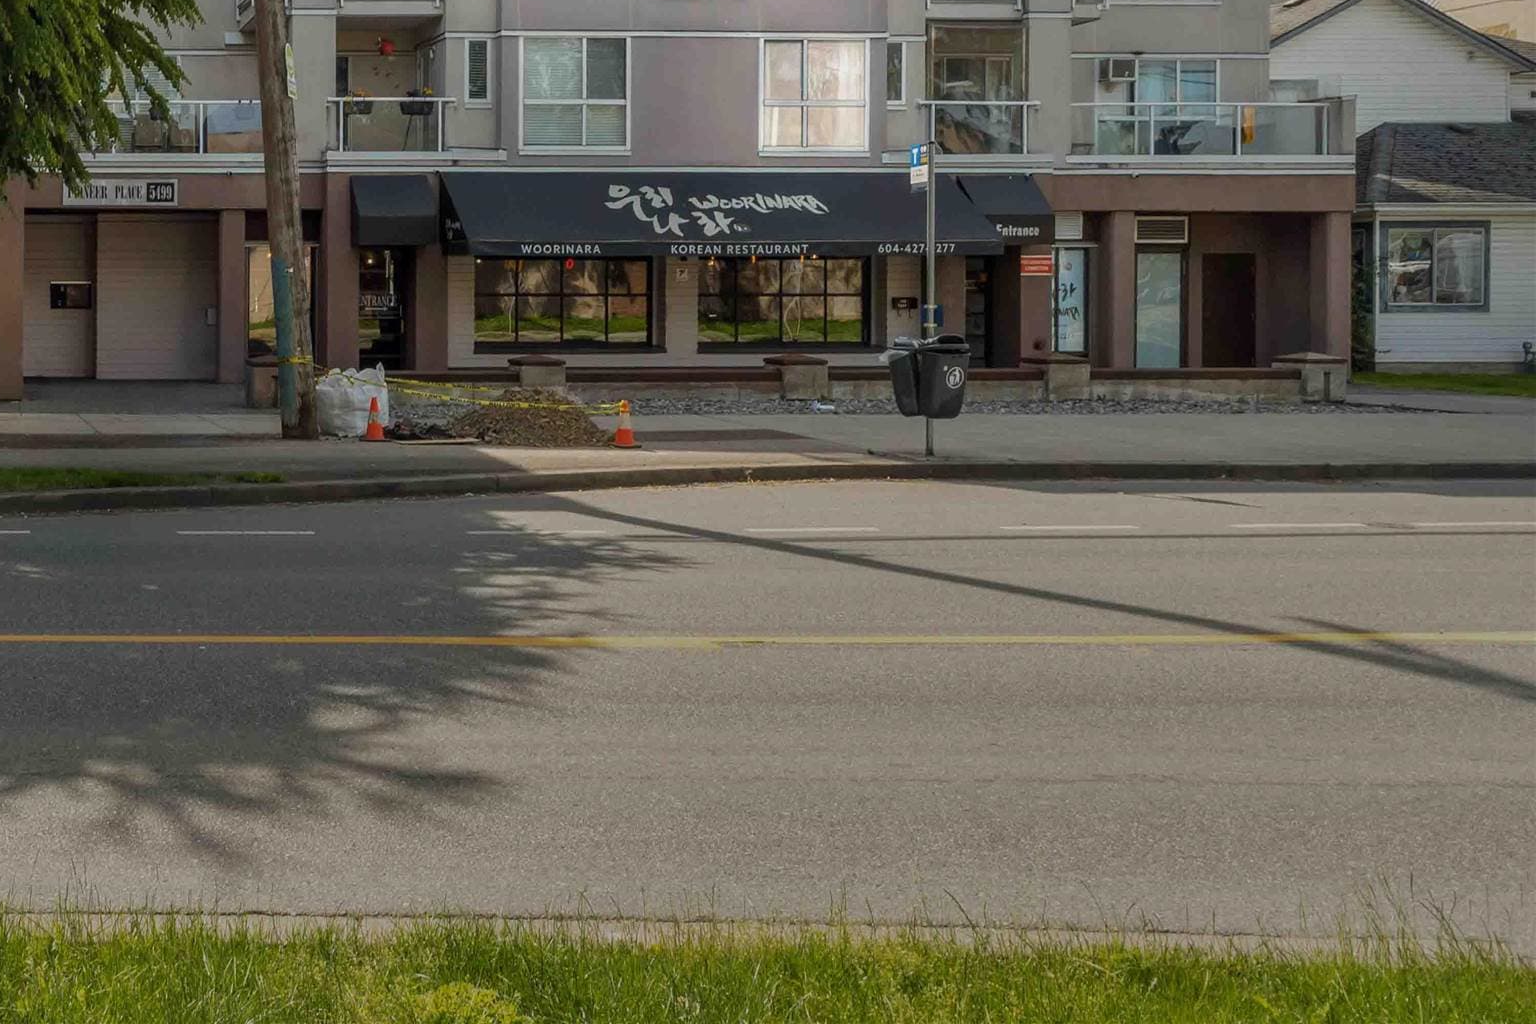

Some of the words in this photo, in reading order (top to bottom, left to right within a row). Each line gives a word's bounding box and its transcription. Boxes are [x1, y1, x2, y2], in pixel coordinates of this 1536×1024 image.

[115, 185, 143, 199] PLACE
[688, 193, 830, 215] WOORINARA
[521, 244, 601, 255] WOORINARA
[670, 244, 722, 255] KOREAN
[726, 244, 809, 255] RESTAURANT
[878, 243, 956, 254] 604-427-277
